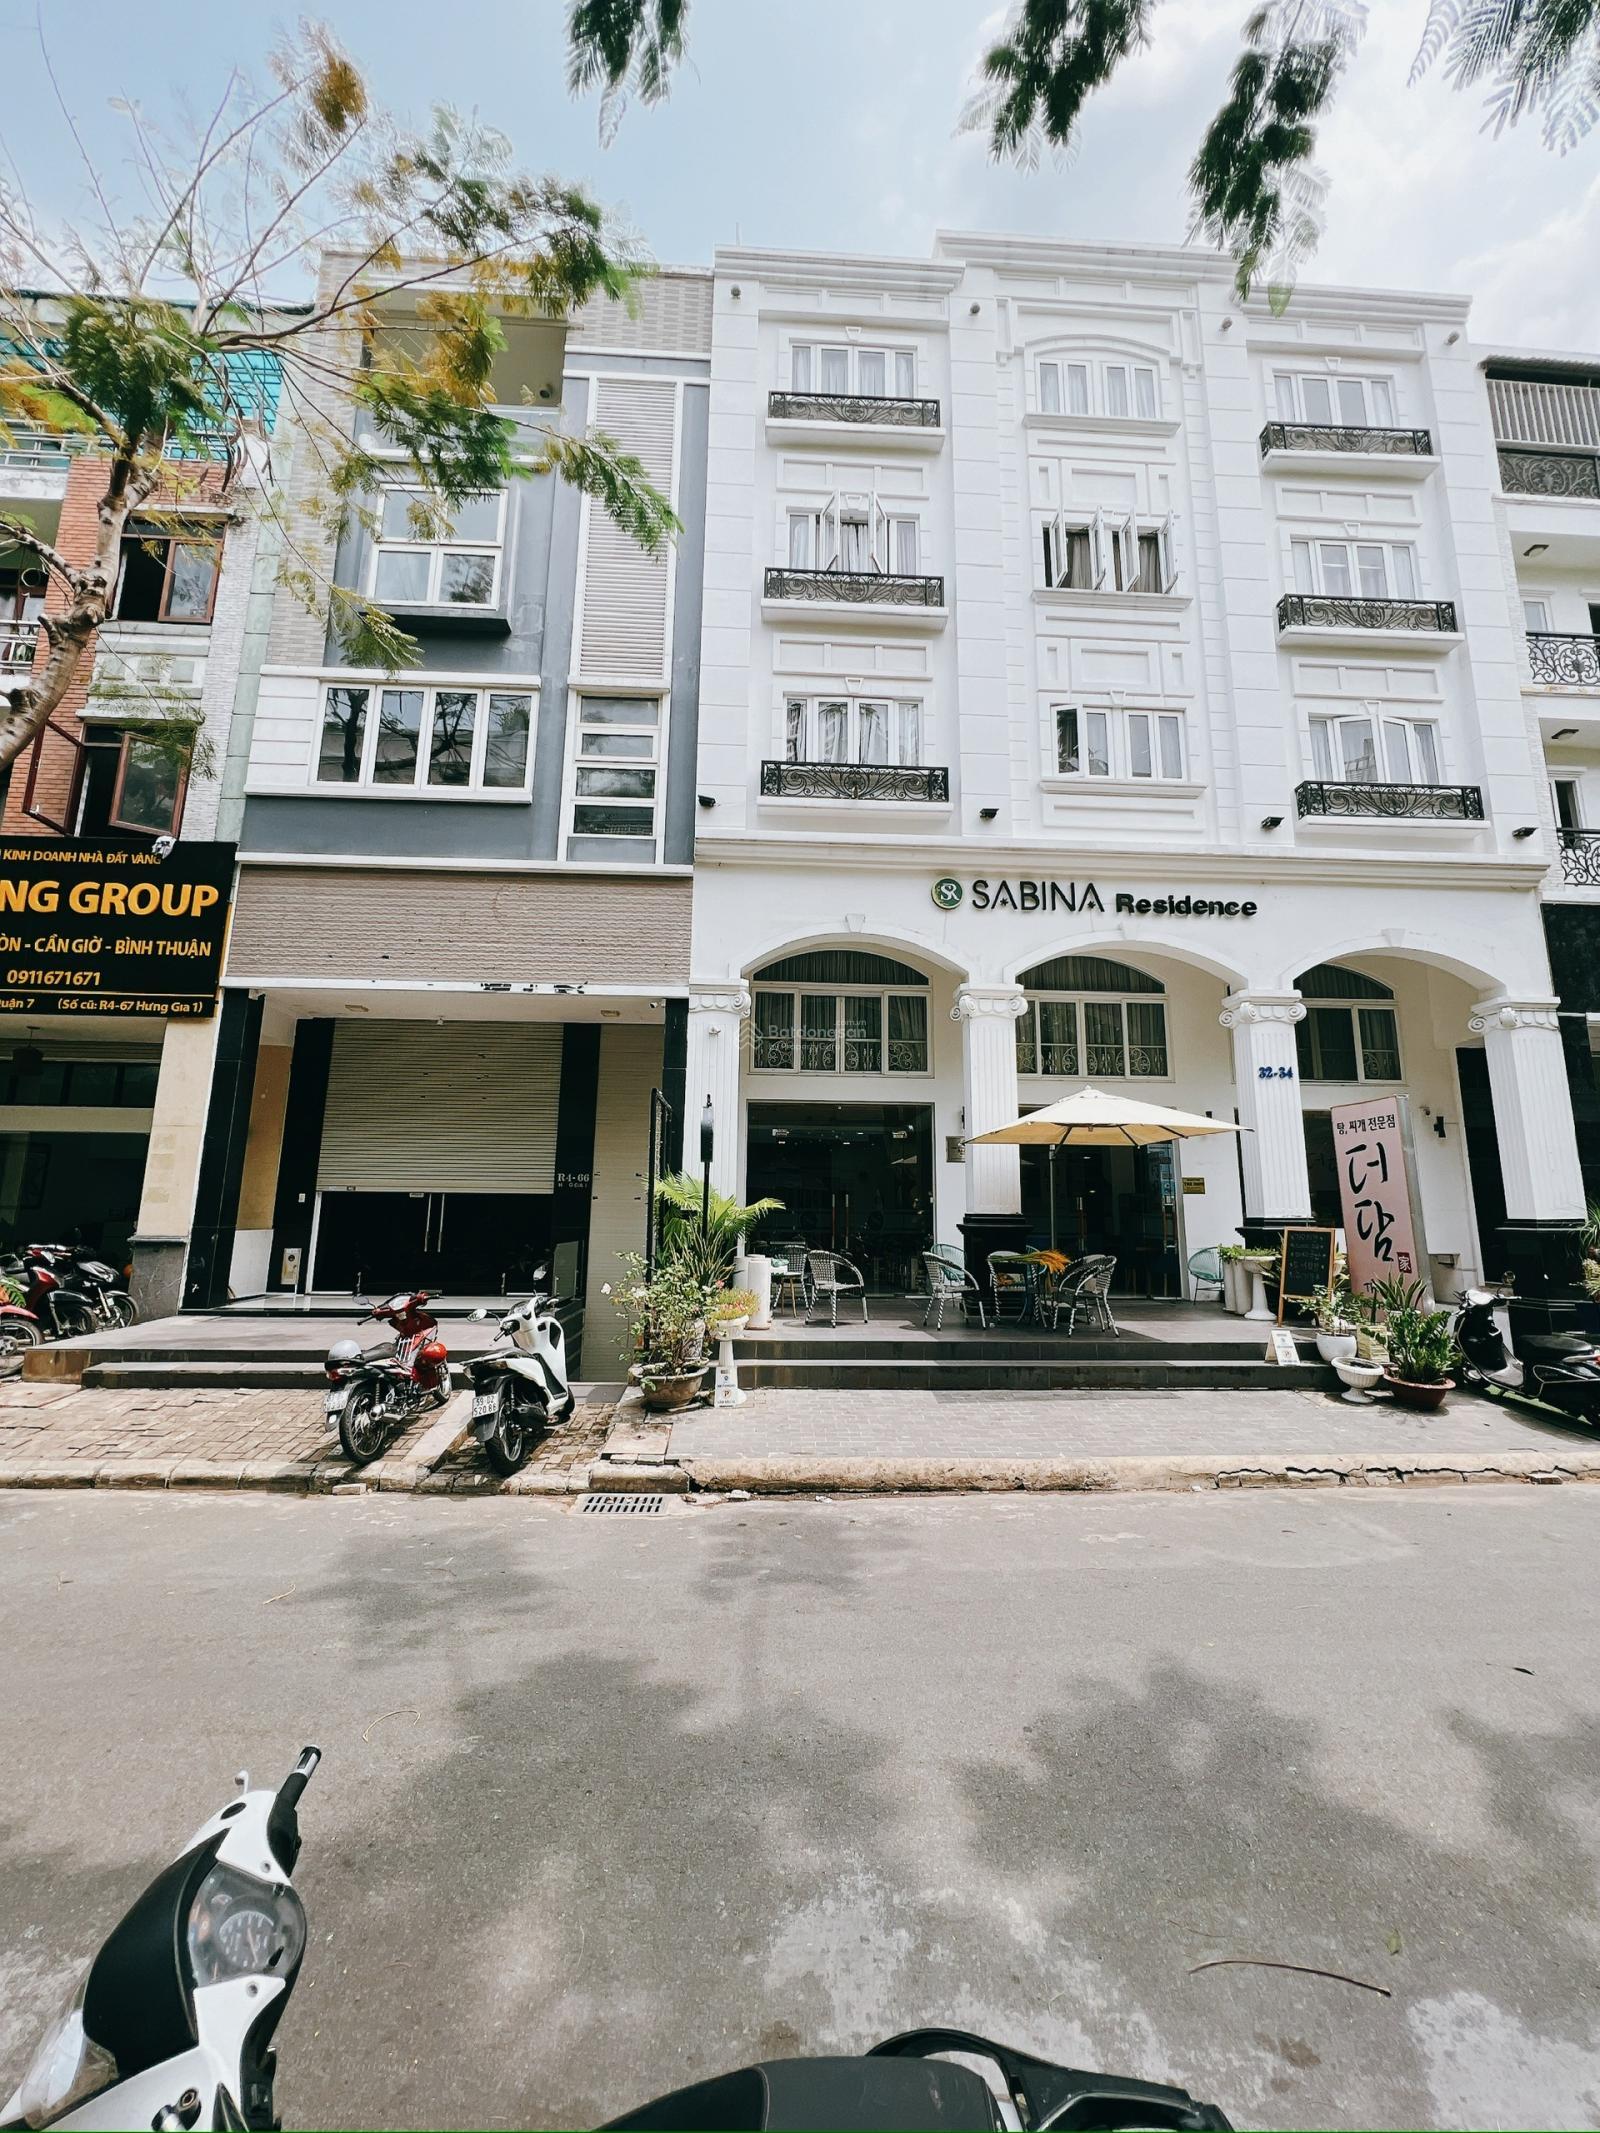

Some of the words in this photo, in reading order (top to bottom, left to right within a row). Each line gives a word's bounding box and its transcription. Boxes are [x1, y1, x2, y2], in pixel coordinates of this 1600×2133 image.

[3, 849, 31, 861] KINH
[33, 850, 77, 862] DOANH
[78, 850, 103, 863] NHÀ
[106, 850, 128, 864] ĐẤT
[0, 880, 60, 913] NG
[69, 881, 219, 917] GROUP
[972, 880, 1105, 912] SABINA
[1115, 893, 1257, 916] Residence
[34, 933, 70, 953] CẦN
[71, 935, 103, 954] GIỜ
[115, 936, 153, 955] BÌNH
[156, 938, 212, 959] THUẬN
[6, 969, 101, 986] 0911671671
[0, 998, 24, 1011] uận
[26, 998, 36, 1009] 7
[58, 998, 79, 1010] (Số
[99, 1000, 134, 1011] R4-67
[136, 1001, 168, 1014] Hưng
[171, 1002, 190, 1012] Gia
[193, 1001, 203, 1013] 1)
[1259, 1066, 1293, 1079] 32-34
[1337, 1122, 1347, 1135] 탕,
[1349, 1119, 1366, 1133] 찌개
[1368, 1114, 1395, 1131] 전문점
